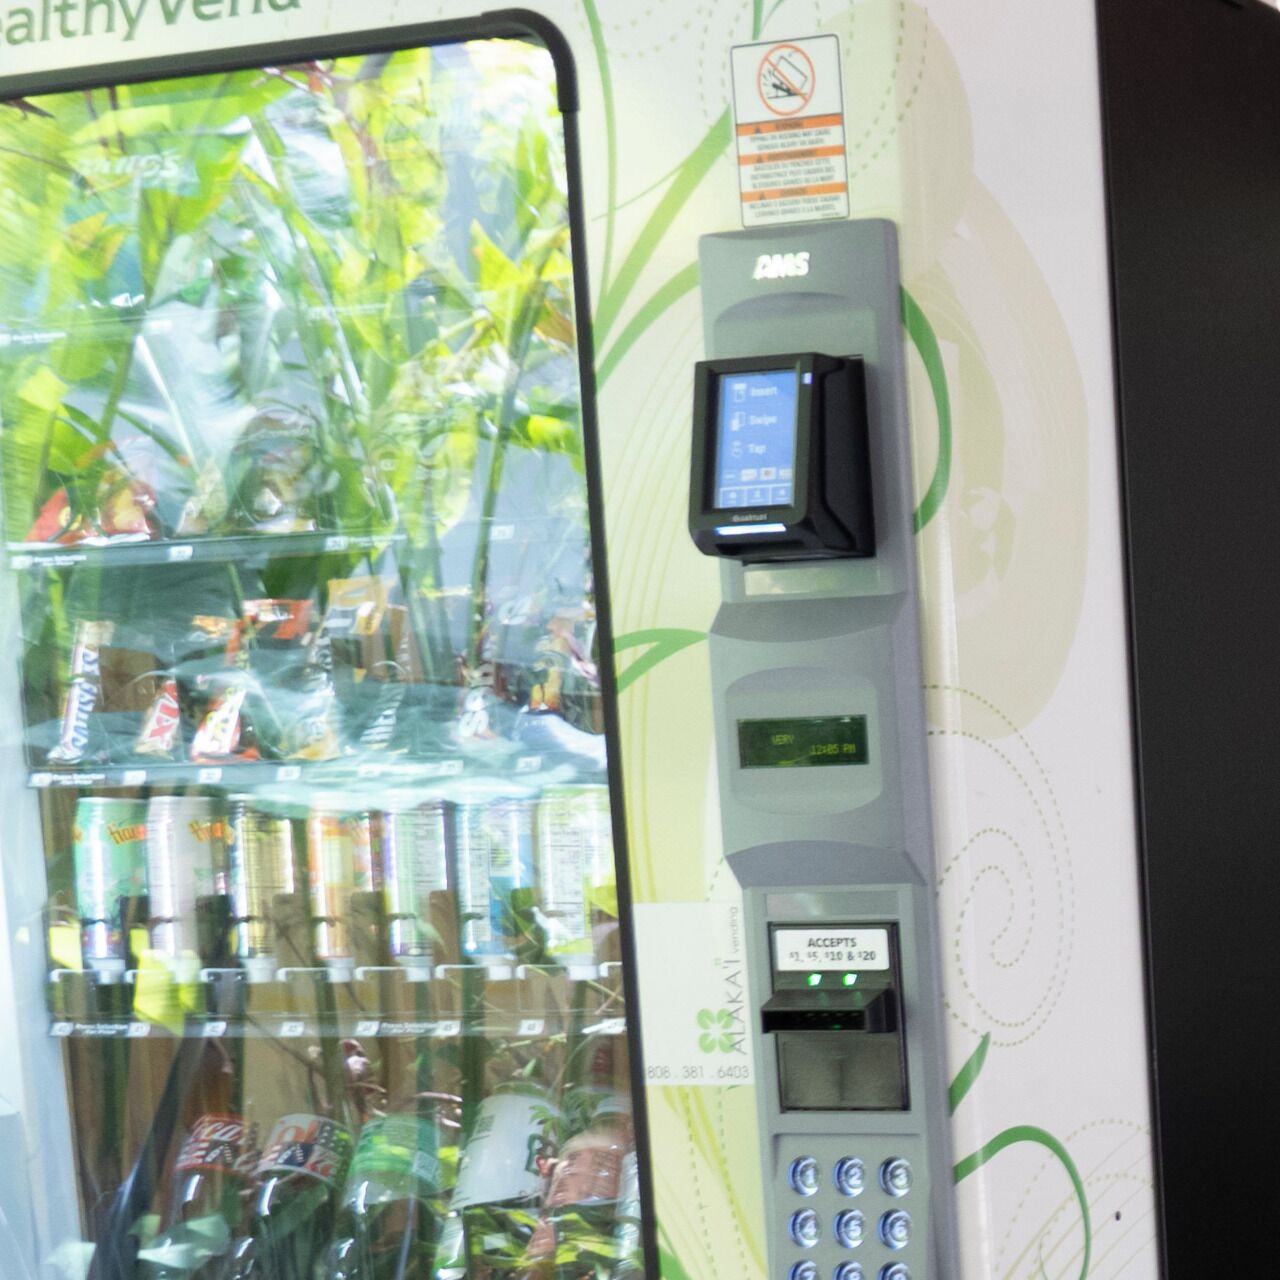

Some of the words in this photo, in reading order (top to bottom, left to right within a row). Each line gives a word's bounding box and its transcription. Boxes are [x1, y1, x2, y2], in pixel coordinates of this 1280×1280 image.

[752, 251, 810, 280] AMS
[807, 937, 858, 948] ACCEPTS
[647, 1065, 671, 1079] 808
[682, 1065, 704, 1079] 381
[717, 1065, 750, 1079] 6403
